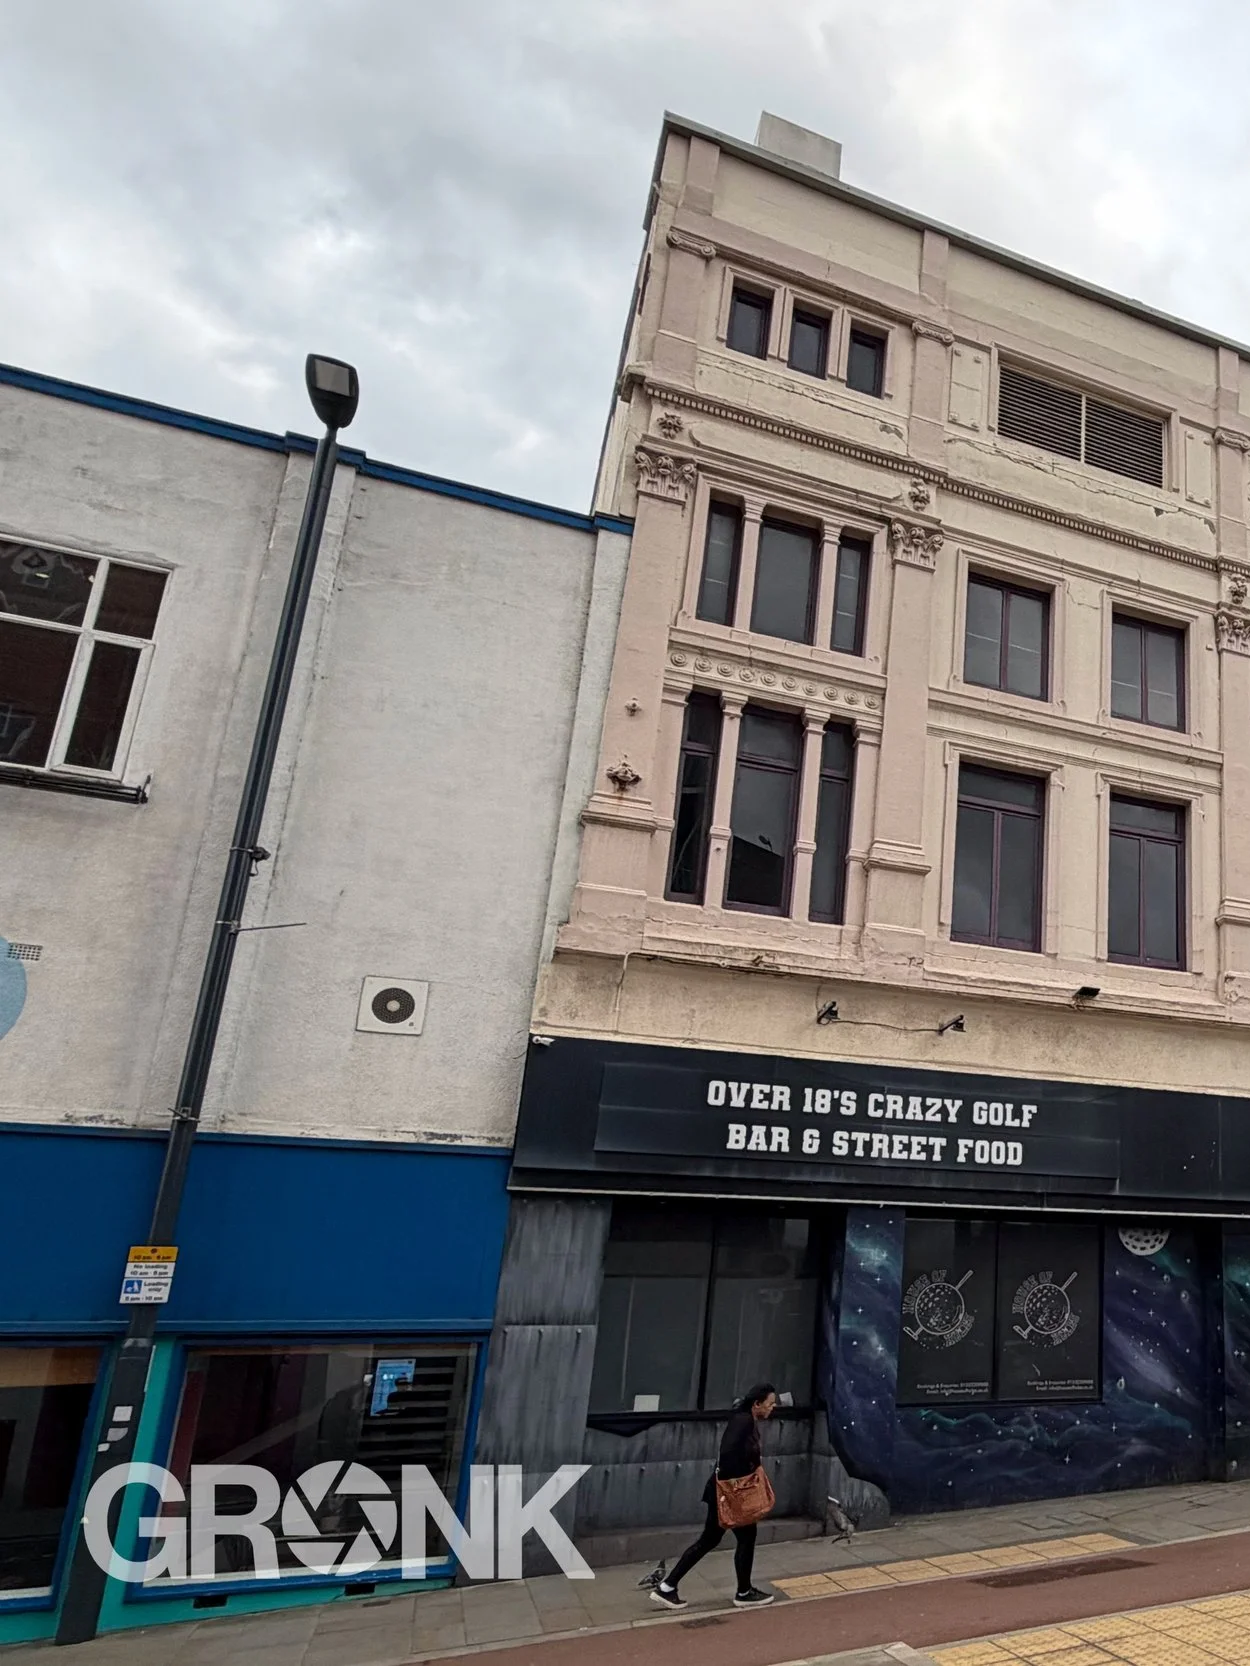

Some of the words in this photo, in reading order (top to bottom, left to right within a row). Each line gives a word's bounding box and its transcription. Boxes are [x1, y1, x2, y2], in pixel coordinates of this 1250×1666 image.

[707, 1080, 791, 1111] OVER
[802, 1087, 857, 1116] 18'S
[867, 1093, 963, 1123] CRAZY
[972, 1099, 1038, 1128] GOLF
[726, 1123, 790, 1153] BAR
[802, 1128, 820, 1154] &
[832, 1130, 947, 1162] STREET
[956, 1138, 1023, 1166] FOOD
